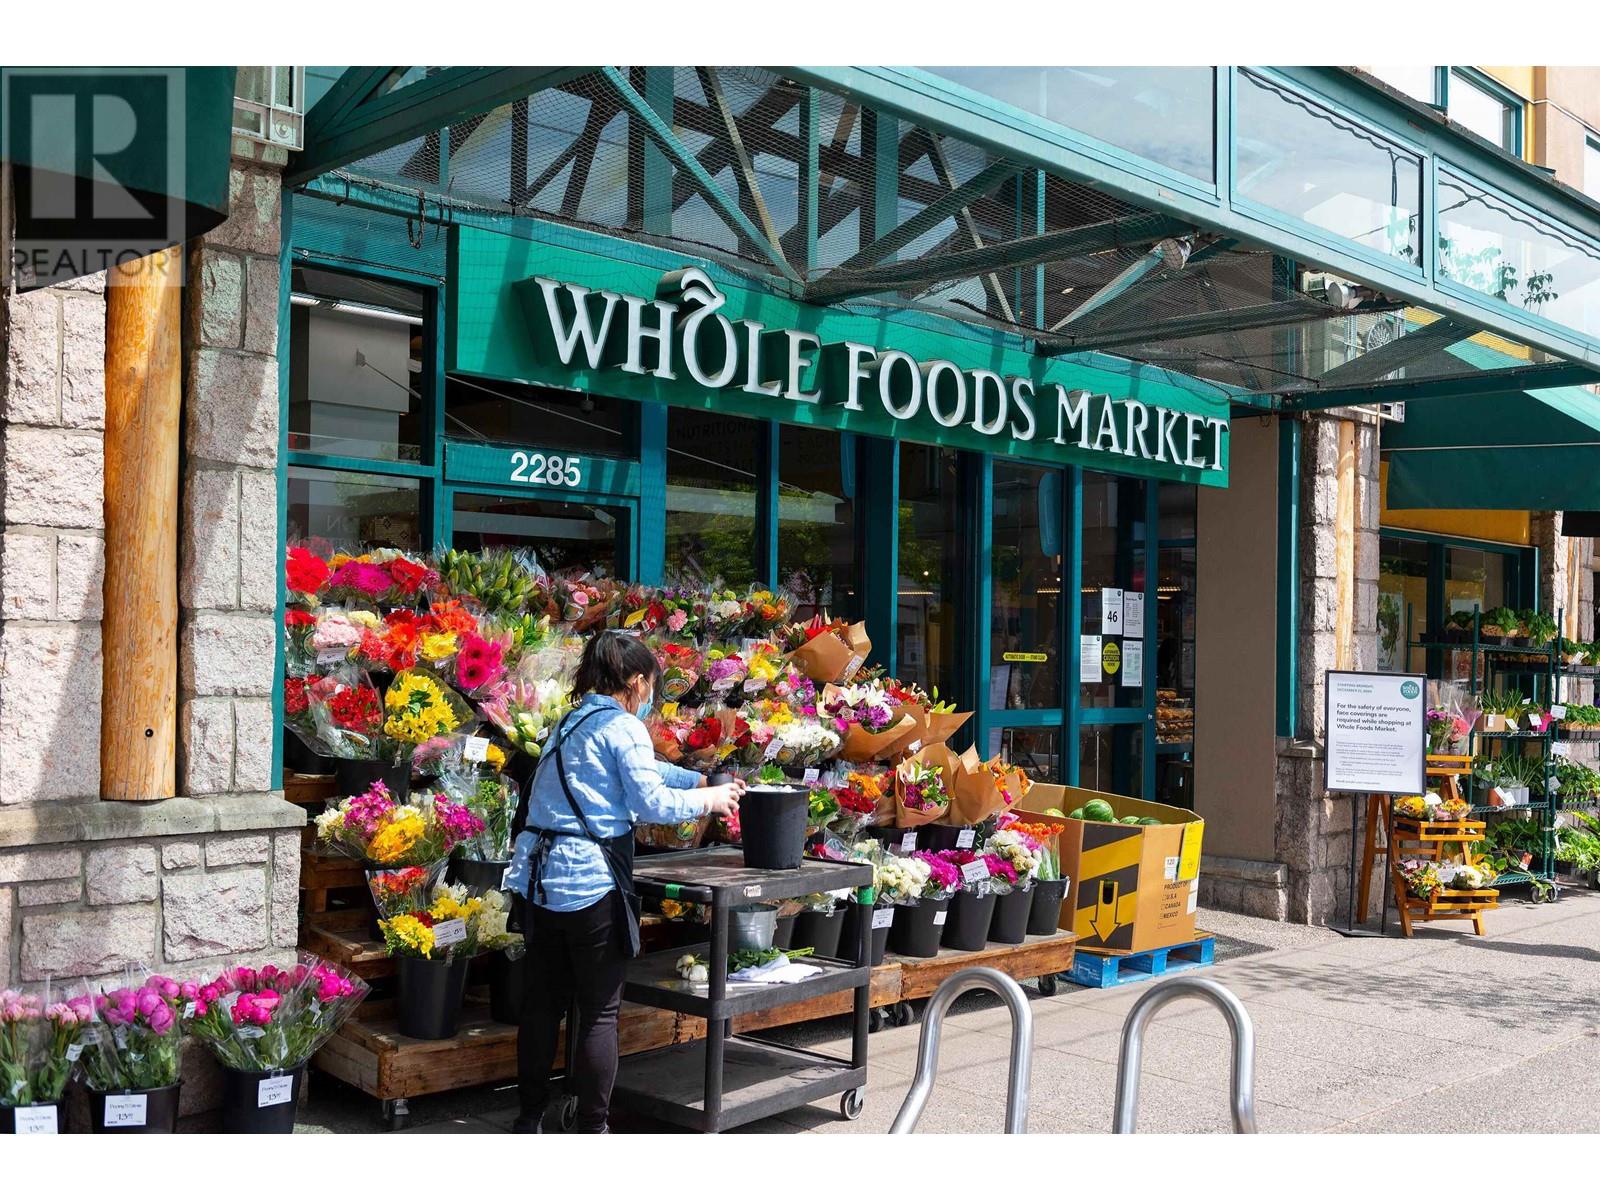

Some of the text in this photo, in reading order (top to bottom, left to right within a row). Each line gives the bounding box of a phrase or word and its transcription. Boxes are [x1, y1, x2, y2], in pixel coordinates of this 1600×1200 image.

[534, 266, 1230, 471] WHOLE FOODS MARKET
[510, 451, 581, 487] 2285
[1107, 610, 1118, 623] 46
[1164, 902, 1181, 910] CANADA
[1163, 911, 1179, 919] MEXICO
